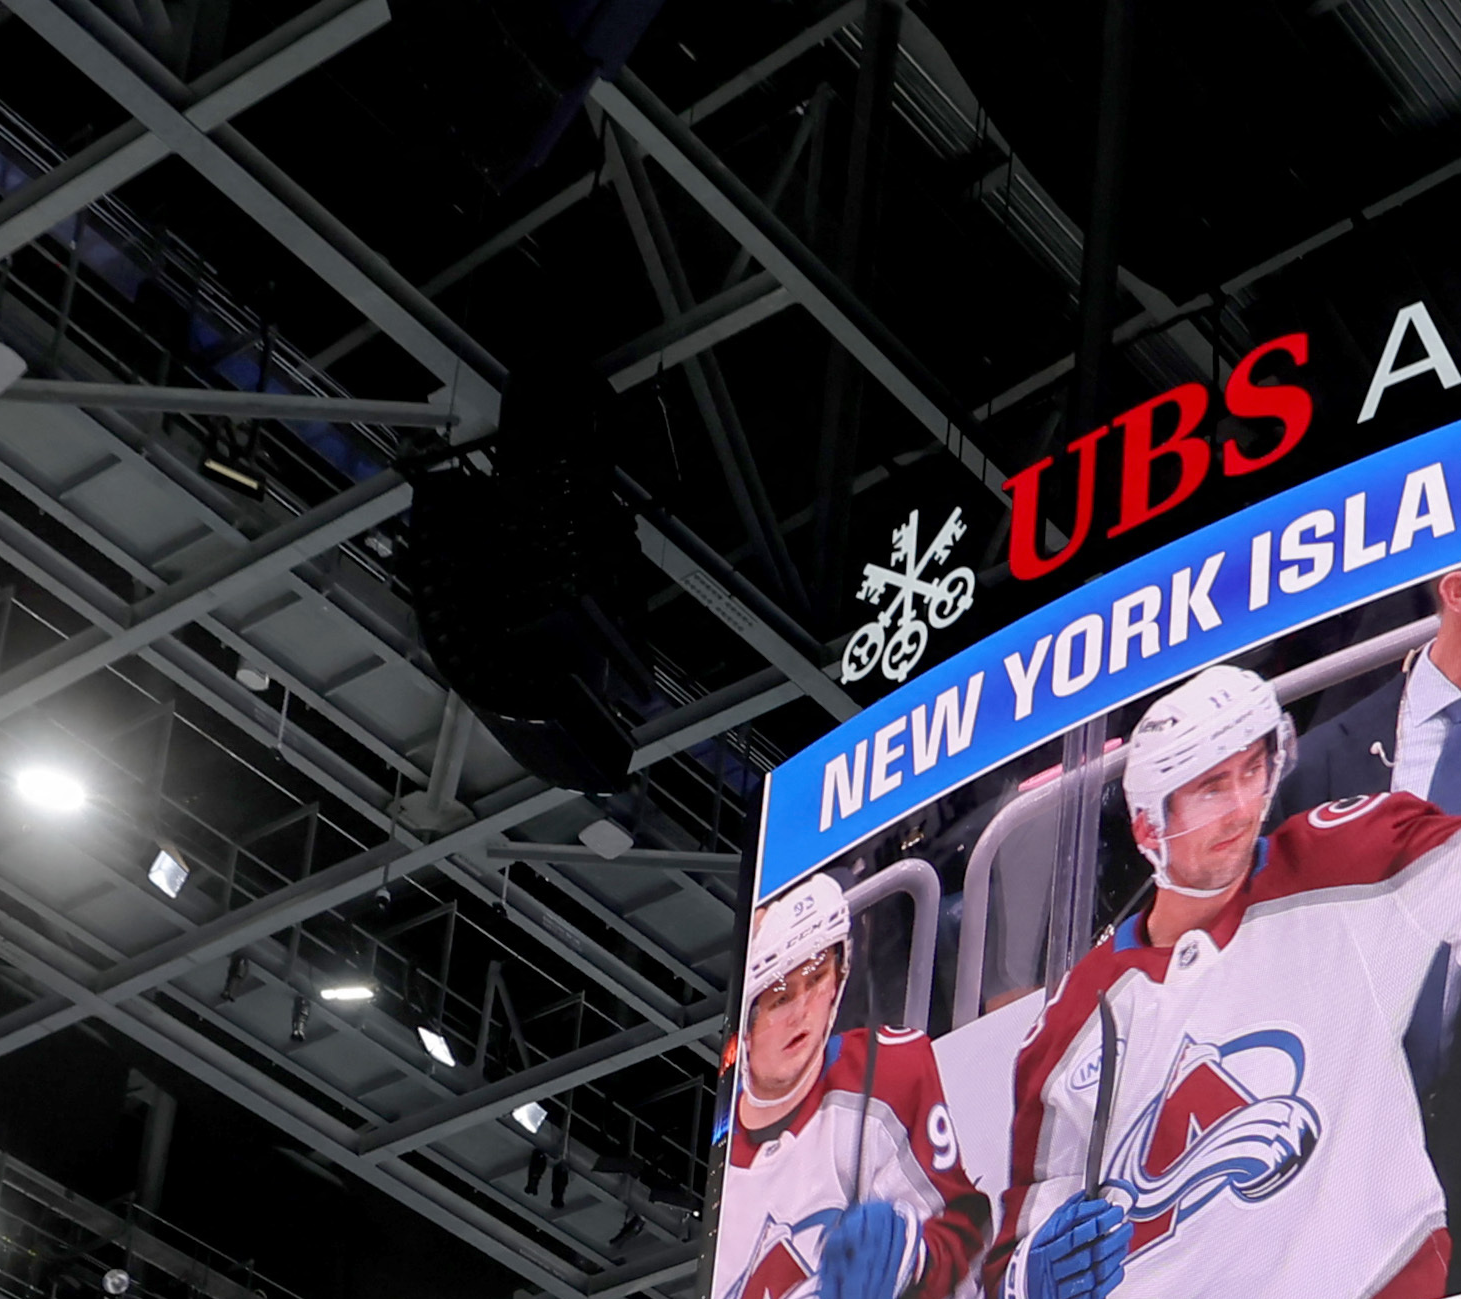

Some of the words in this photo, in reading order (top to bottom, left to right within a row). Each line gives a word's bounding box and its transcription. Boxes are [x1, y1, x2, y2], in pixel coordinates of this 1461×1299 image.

[1001, 331, 1314, 582] UBS
[818, 688, 981, 832] NEW
[1005, 551, 1224, 717] YORK
